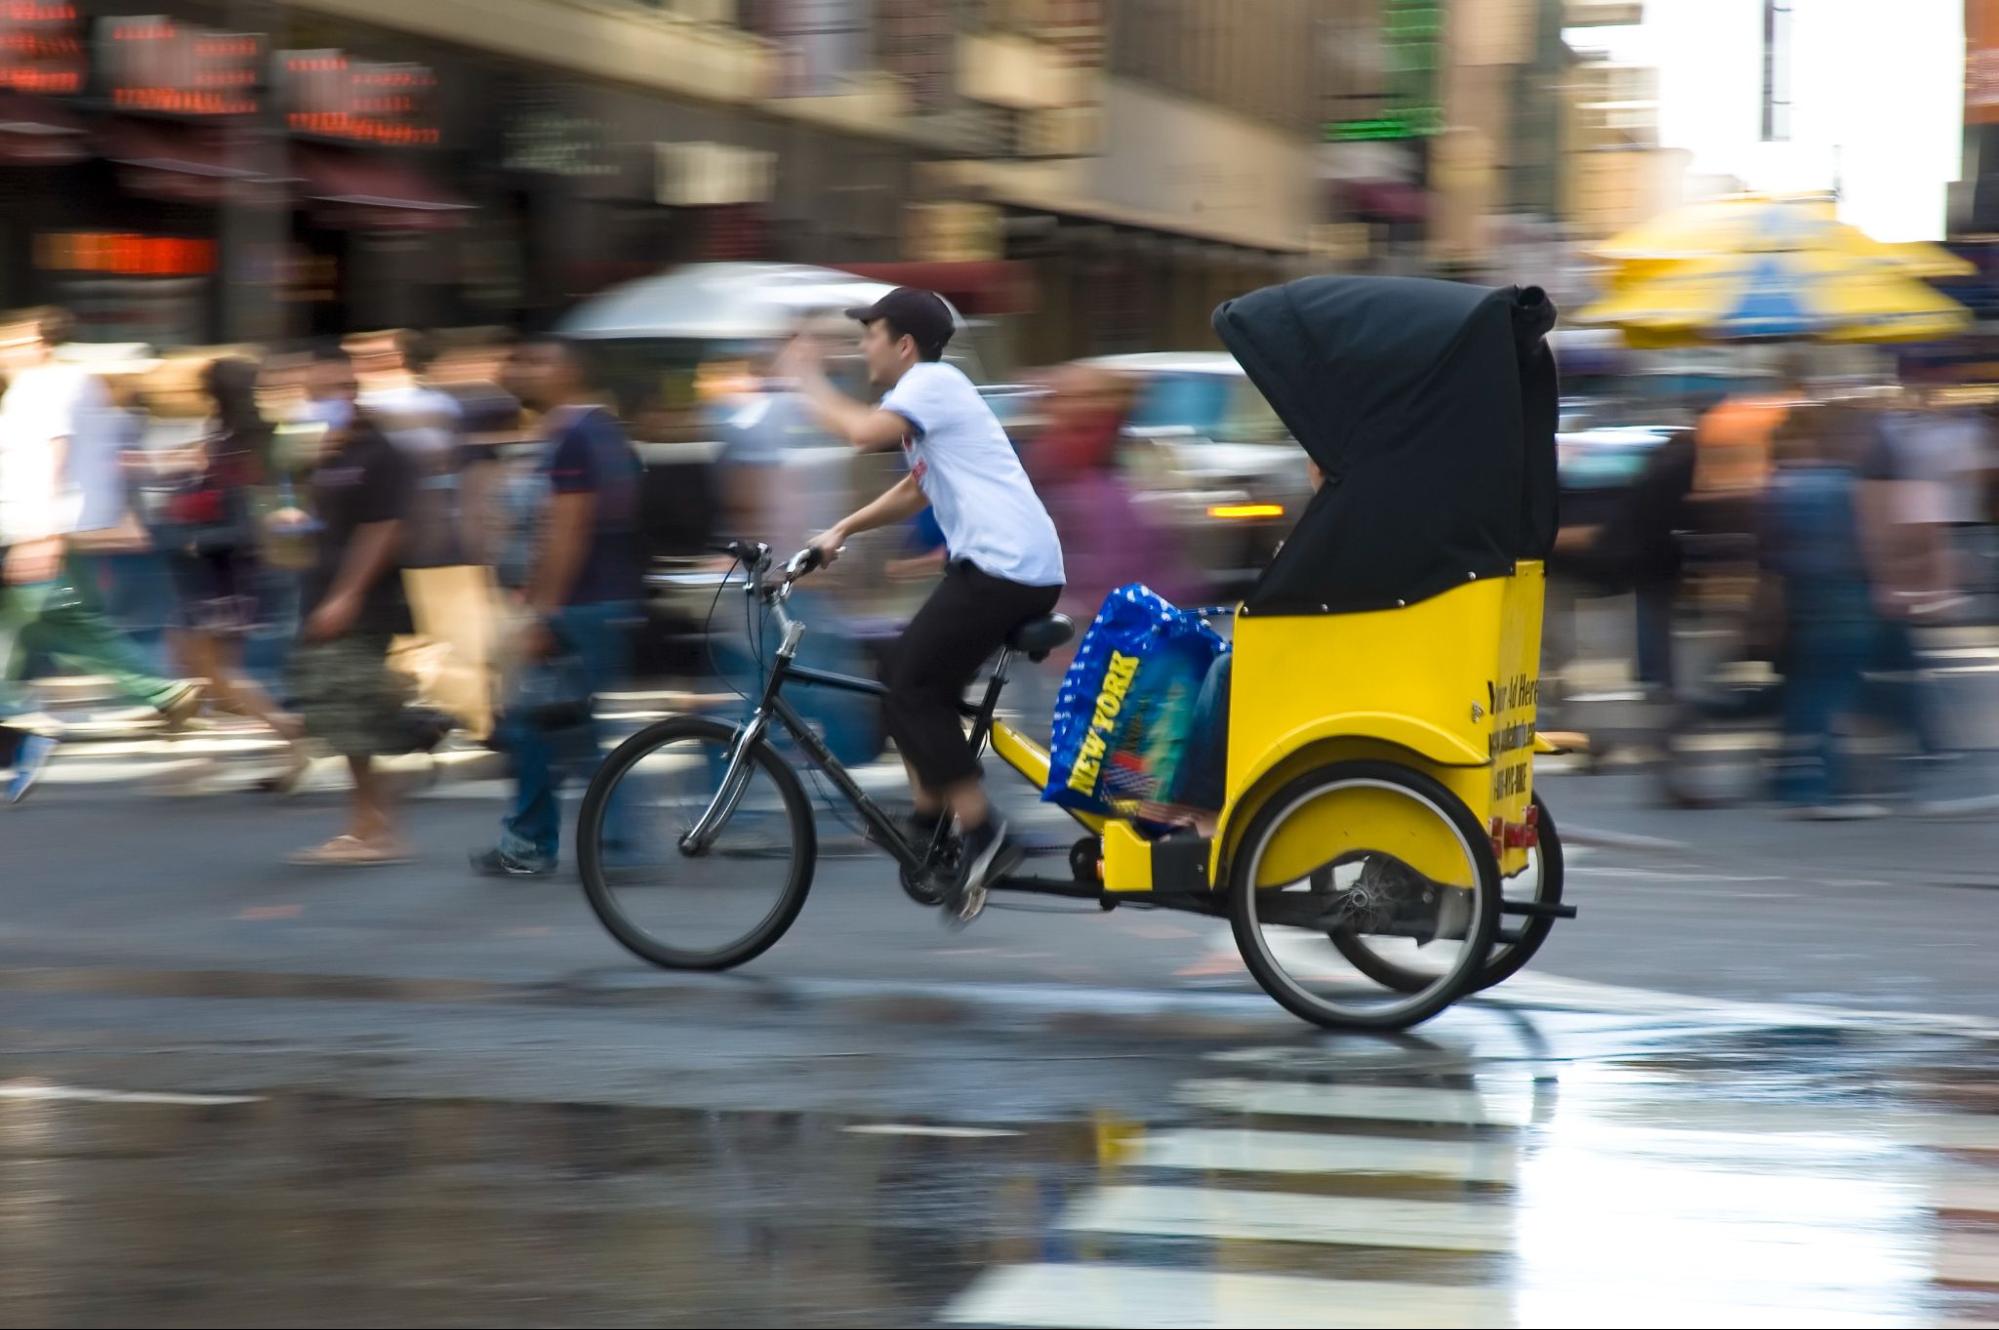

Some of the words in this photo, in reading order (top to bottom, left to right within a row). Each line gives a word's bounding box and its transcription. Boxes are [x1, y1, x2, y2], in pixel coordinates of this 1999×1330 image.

[1068, 725, 1106, 797] NEW
[1092, 650, 1140, 733] YORK
[1518, 673, 1539, 707] Here
